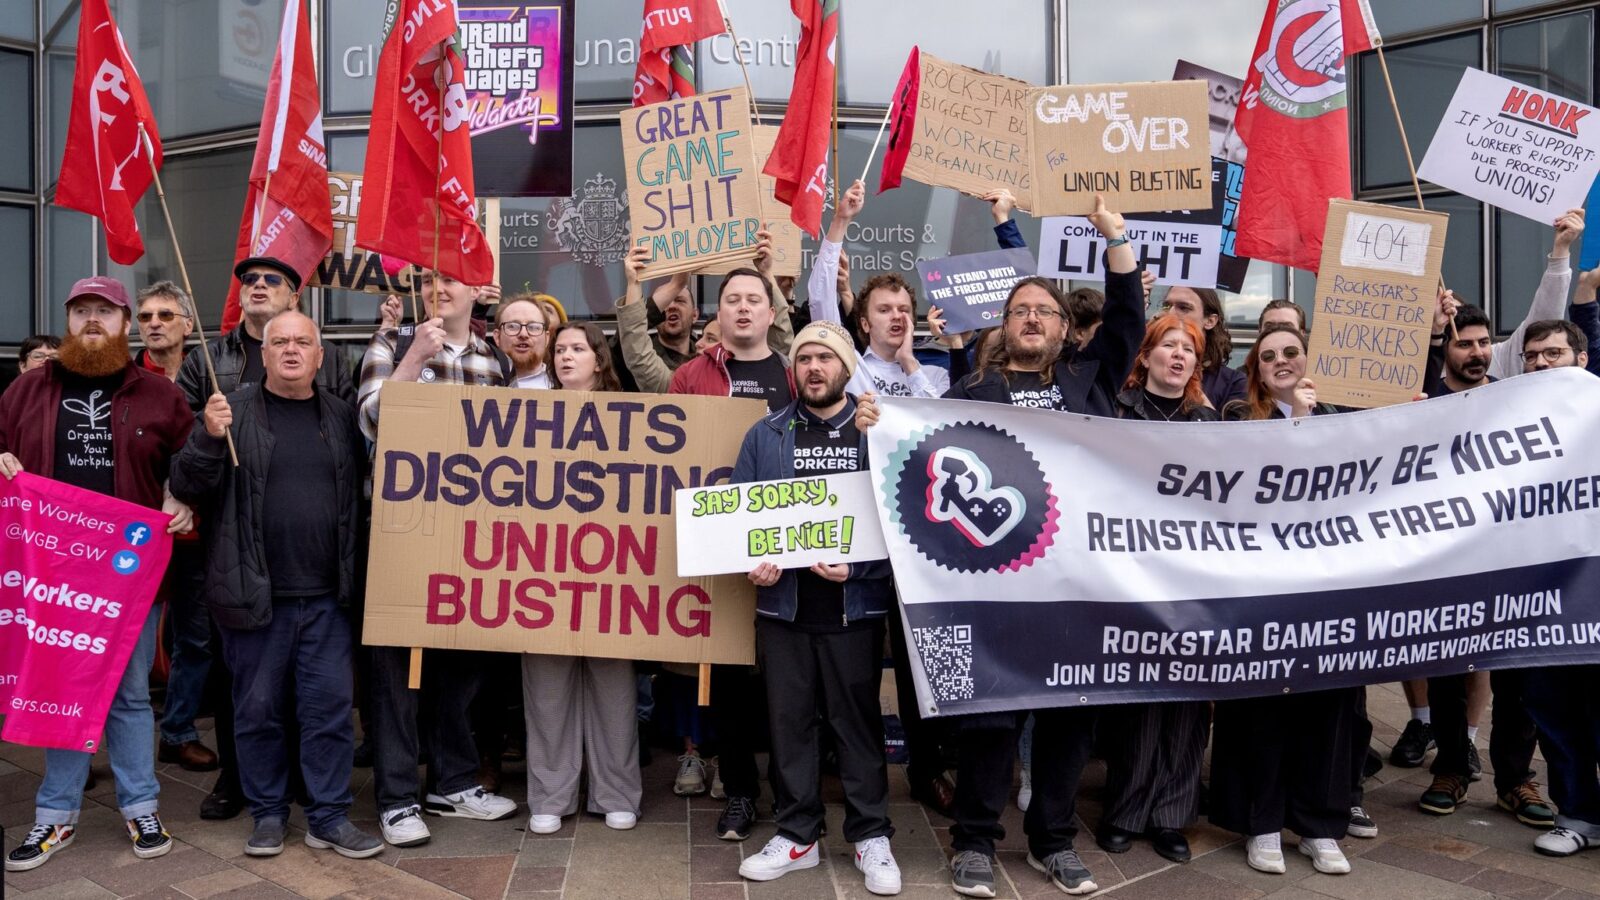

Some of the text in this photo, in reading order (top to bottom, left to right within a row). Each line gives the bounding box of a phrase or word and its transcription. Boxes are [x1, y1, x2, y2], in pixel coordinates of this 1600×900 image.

[924, 63, 1027, 110] ROCKSTAR
[636, 95, 731, 144] GREAT
[921, 91, 1027, 136] BIGGEST BU
[1036, 91, 1129, 124] GAME
[1501, 86, 1591, 135] HONK
[924, 115, 1028, 167] WORKER
[1102, 117, 1190, 153] OVER
[1455, 110, 1596, 162] IF YOU SUPPORT:
[637, 130, 743, 186] GAME
[910, 142, 1030, 189] ORGANISING
[1471, 151, 1561, 182] DUE PROCESS!
[1528, 150, 1579, 173] RIGHTS!
[1064, 171, 1120, 192] UNION
[1130, 168, 1202, 192] BUSTING
[1474, 166, 1555, 205] UNIONS!
[643, 175, 737, 231] SHIT
[844, 221, 915, 243] Courts
[1128, 229, 1148, 240] UT
[1152, 231, 1166, 242] IN
[1172, 232, 1199, 244] THE
[1356, 221, 1408, 262] 404
[954, 271, 987, 284] STAND
[988, 266, 1016, 278] WITH
[1058, 239, 1201, 280] LIHT
[931, 290, 953, 300] THE
[954, 283, 985, 296] FIRED
[1333, 274, 1418, 302] ROCKSTAR'S
[1324, 297, 1425, 324] RESPECT FOR
[1330, 320, 1420, 357] WORKERS
[1315, 354, 1418, 389] NOT FOUND
[68, 430, 113, 443] Organis
[461, 399, 687, 455] WHATS
[68, 453, 114, 469] Workpla
[794, 458, 858, 470] ORKERS
[1157, 416, 1564, 504] SAY SORRY, BE NICE!
[692, 478, 838, 517] SAY SORRY,
[39, 500, 116, 535] Workers
[1086, 512, 1262, 552] REINSTATE
[1271, 515, 1364, 550] YOUR
[1368, 496, 1477, 539] FIRED
[463, 520, 659, 576] UNION
[748, 526, 783, 557] BE
[426, 574, 712, 638] BUSTING
[1103, 589, 1562, 656] ROCKSTAR GAMES WORKERS UNION
[1046, 662, 1095, 686] JOIN
[1103, 662, 1131, 683] US
[1139, 662, 1160, 683] IN
[1168, 658, 1296, 683] SOLIDARITY
[1317, 622, 1600, 674] WWW.GAMEWORKERS.CO.UK
